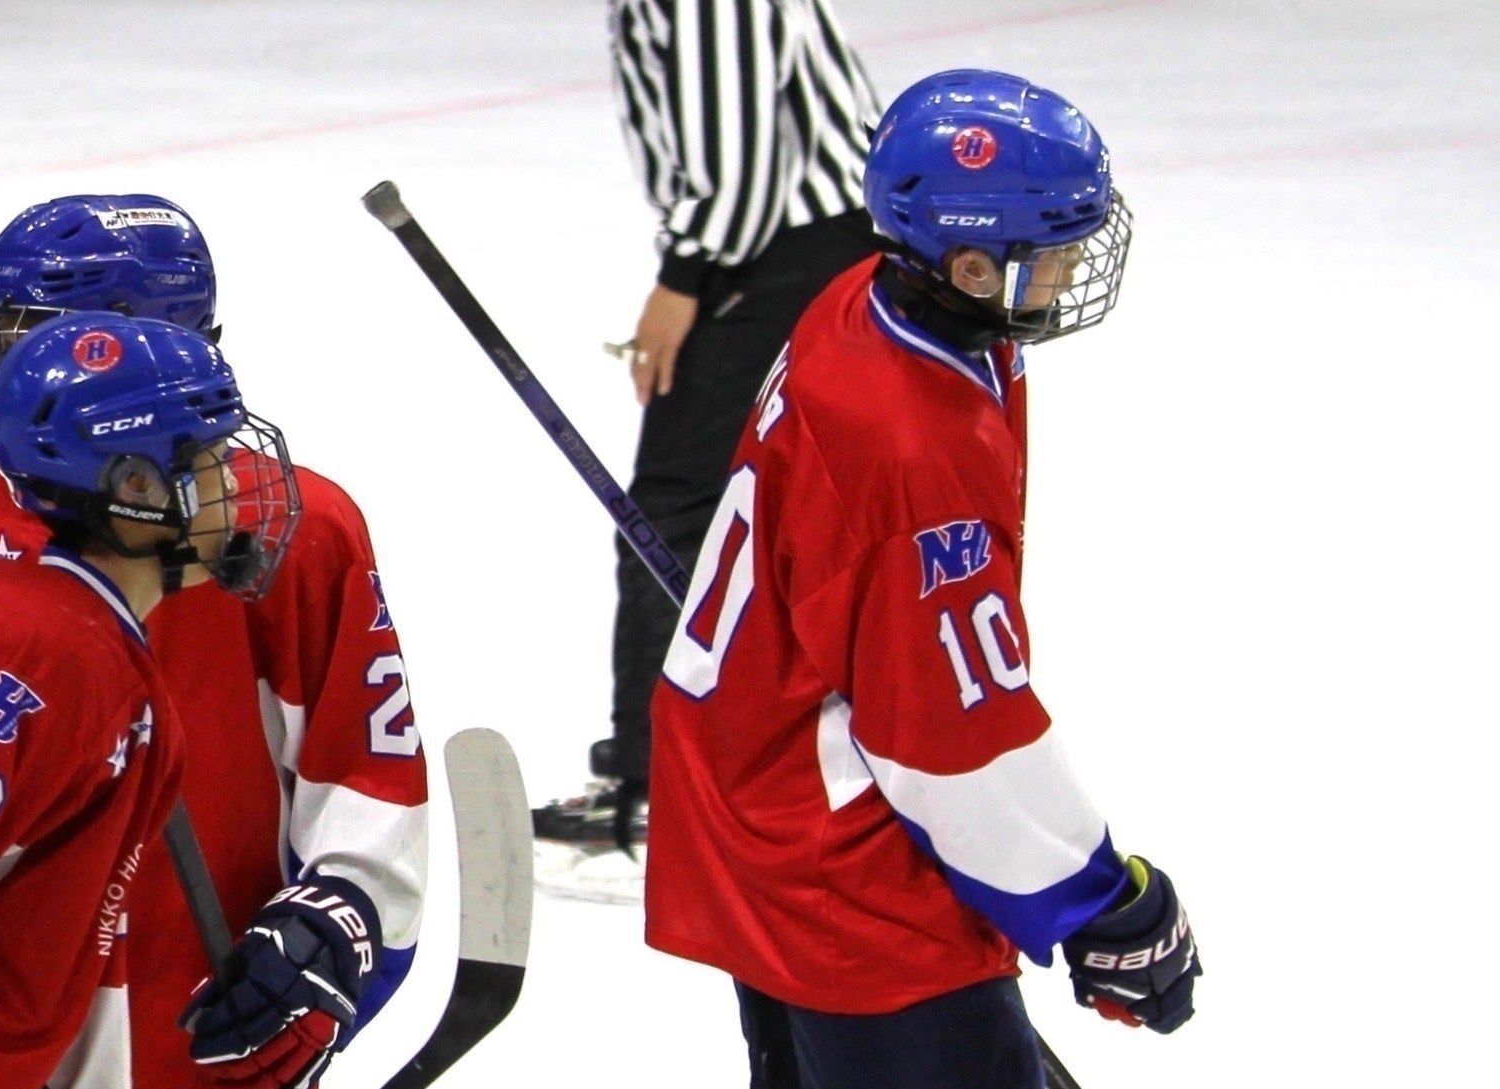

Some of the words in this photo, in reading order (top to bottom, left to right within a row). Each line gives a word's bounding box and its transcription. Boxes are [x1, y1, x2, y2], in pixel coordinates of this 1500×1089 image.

[938, 214, 997, 226] CCM
[91, 413, 154, 435] CCM
[107, 503, 165, 521] BAUER
[937, 591, 1030, 712] 10
[98, 883, 125, 956] NIKKO
[263, 885, 373, 978] AUER
